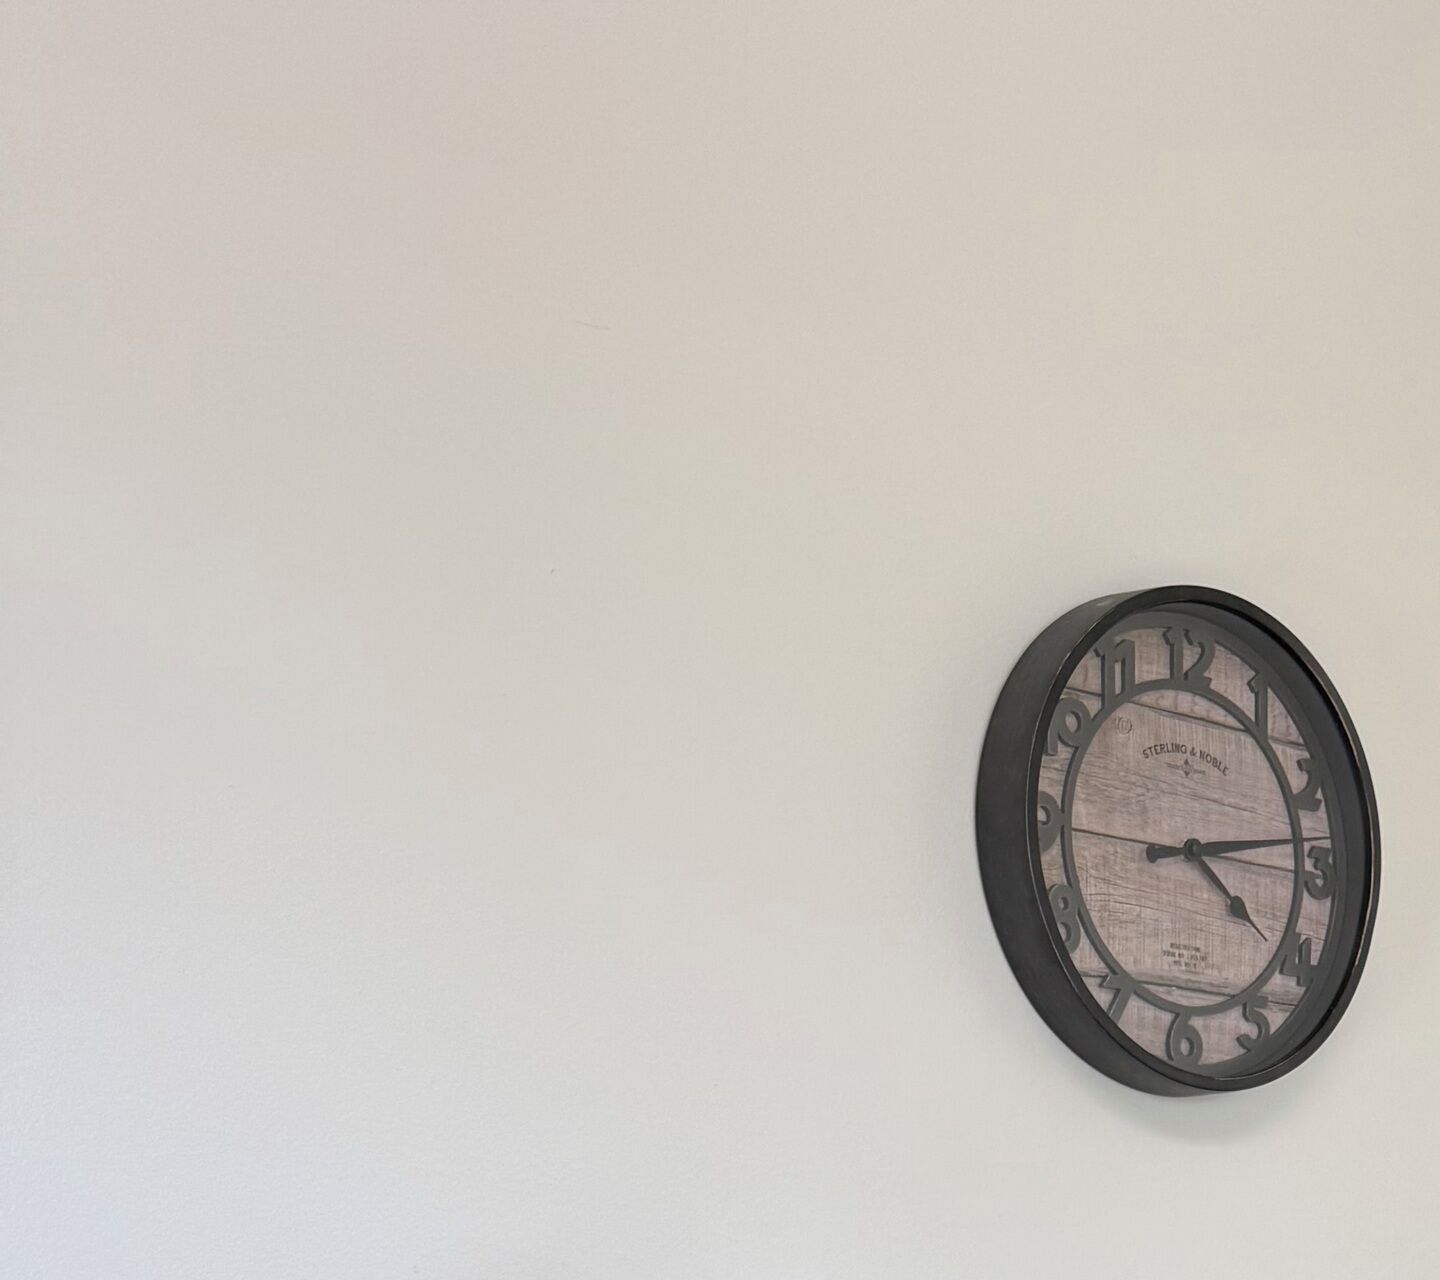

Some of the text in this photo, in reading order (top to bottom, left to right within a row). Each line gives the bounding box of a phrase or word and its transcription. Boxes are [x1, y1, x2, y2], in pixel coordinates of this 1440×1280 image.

[1094, 639, 1136, 708] 11
[1163, 627, 1217, 689] 12
[1247, 670, 1269, 737] 1
[1142, 742, 1229, 777] STERLING & NOBLE
[1297, 758, 1323, 812] 2
[1303, 846, 1335, 899] 3
[1048, 884, 1081, 954] 8
[1279, 936, 1320, 988] 4
[1099, 974, 1137, 1026] 7
[1235, 994, 1271, 1051] 5
[1165, 1011, 1203, 1065] 6
